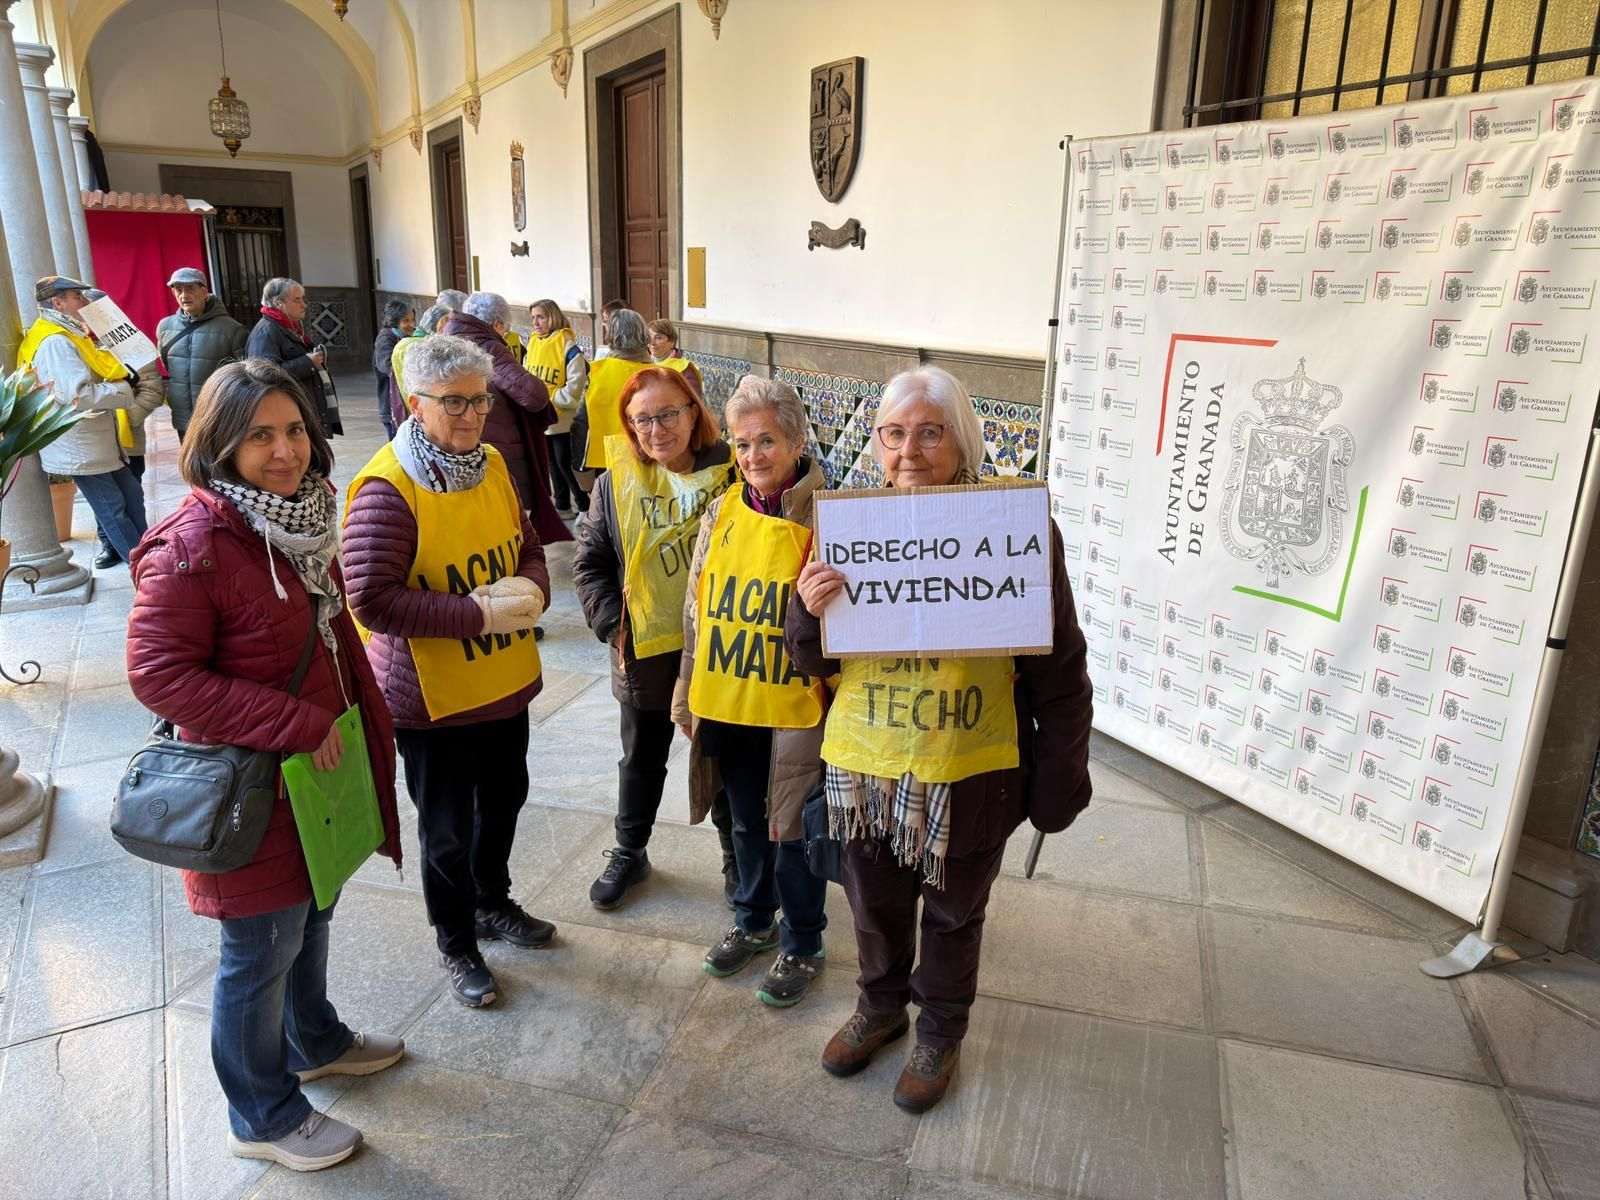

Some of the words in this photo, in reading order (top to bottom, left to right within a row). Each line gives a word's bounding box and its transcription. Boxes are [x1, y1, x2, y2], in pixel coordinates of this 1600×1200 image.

[825, 538, 960, 565] ¡DERECHO
[974, 536, 992, 558] A
[1006, 534, 1042, 557] LA
[708, 573, 736, 622] LA
[844, 576, 1025, 606] VIVIENDA!
[862, 682, 983, 731] TECHO
